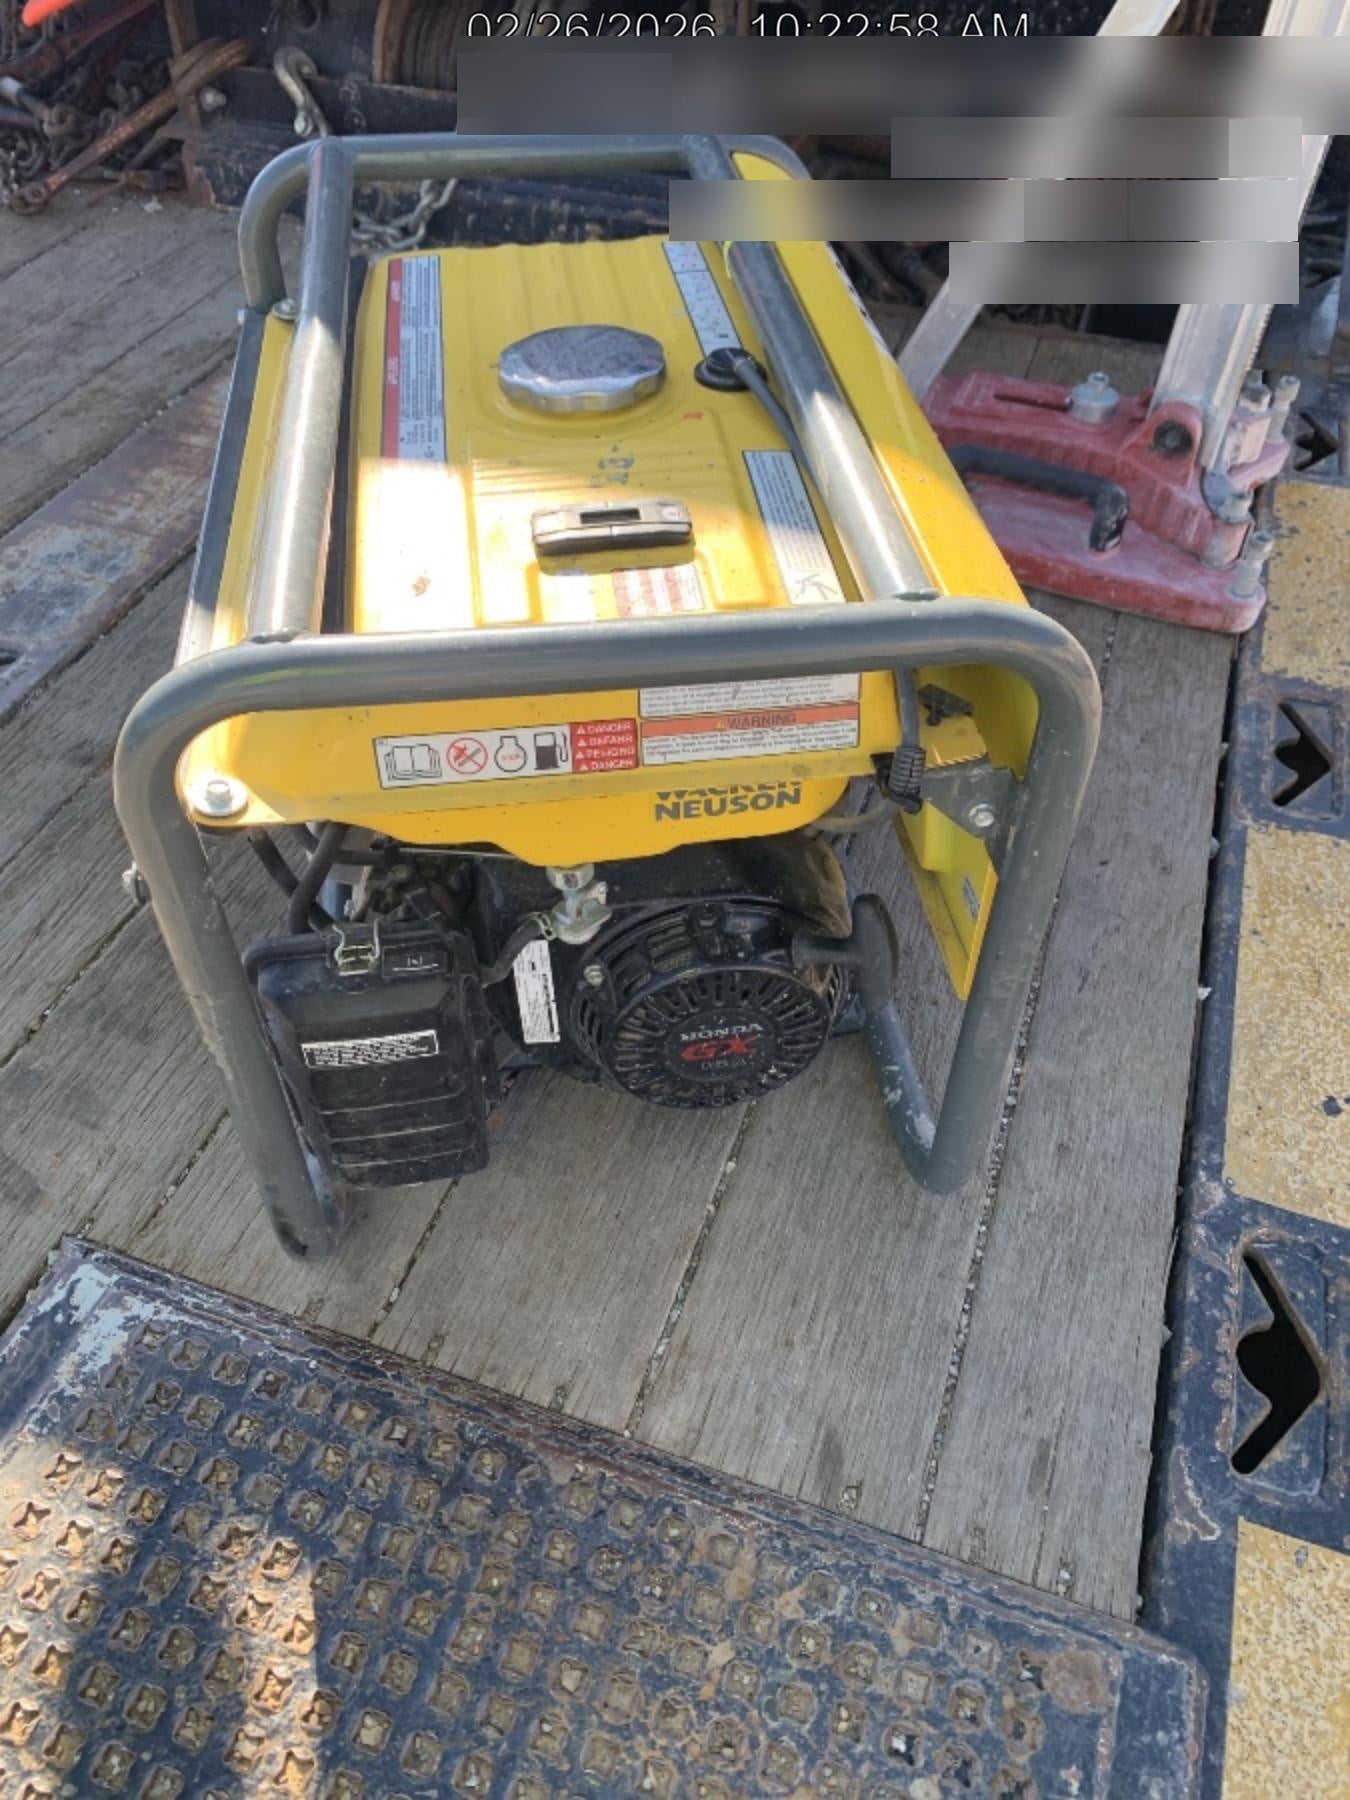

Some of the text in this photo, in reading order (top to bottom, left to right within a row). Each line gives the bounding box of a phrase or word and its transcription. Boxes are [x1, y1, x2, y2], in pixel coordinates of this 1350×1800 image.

[727, 712, 797, 730] WARNING
[654, 787, 801, 822] NEUSON
[680, 1023, 764, 1041] HONDA
[680, 1032, 758, 1063] GX
